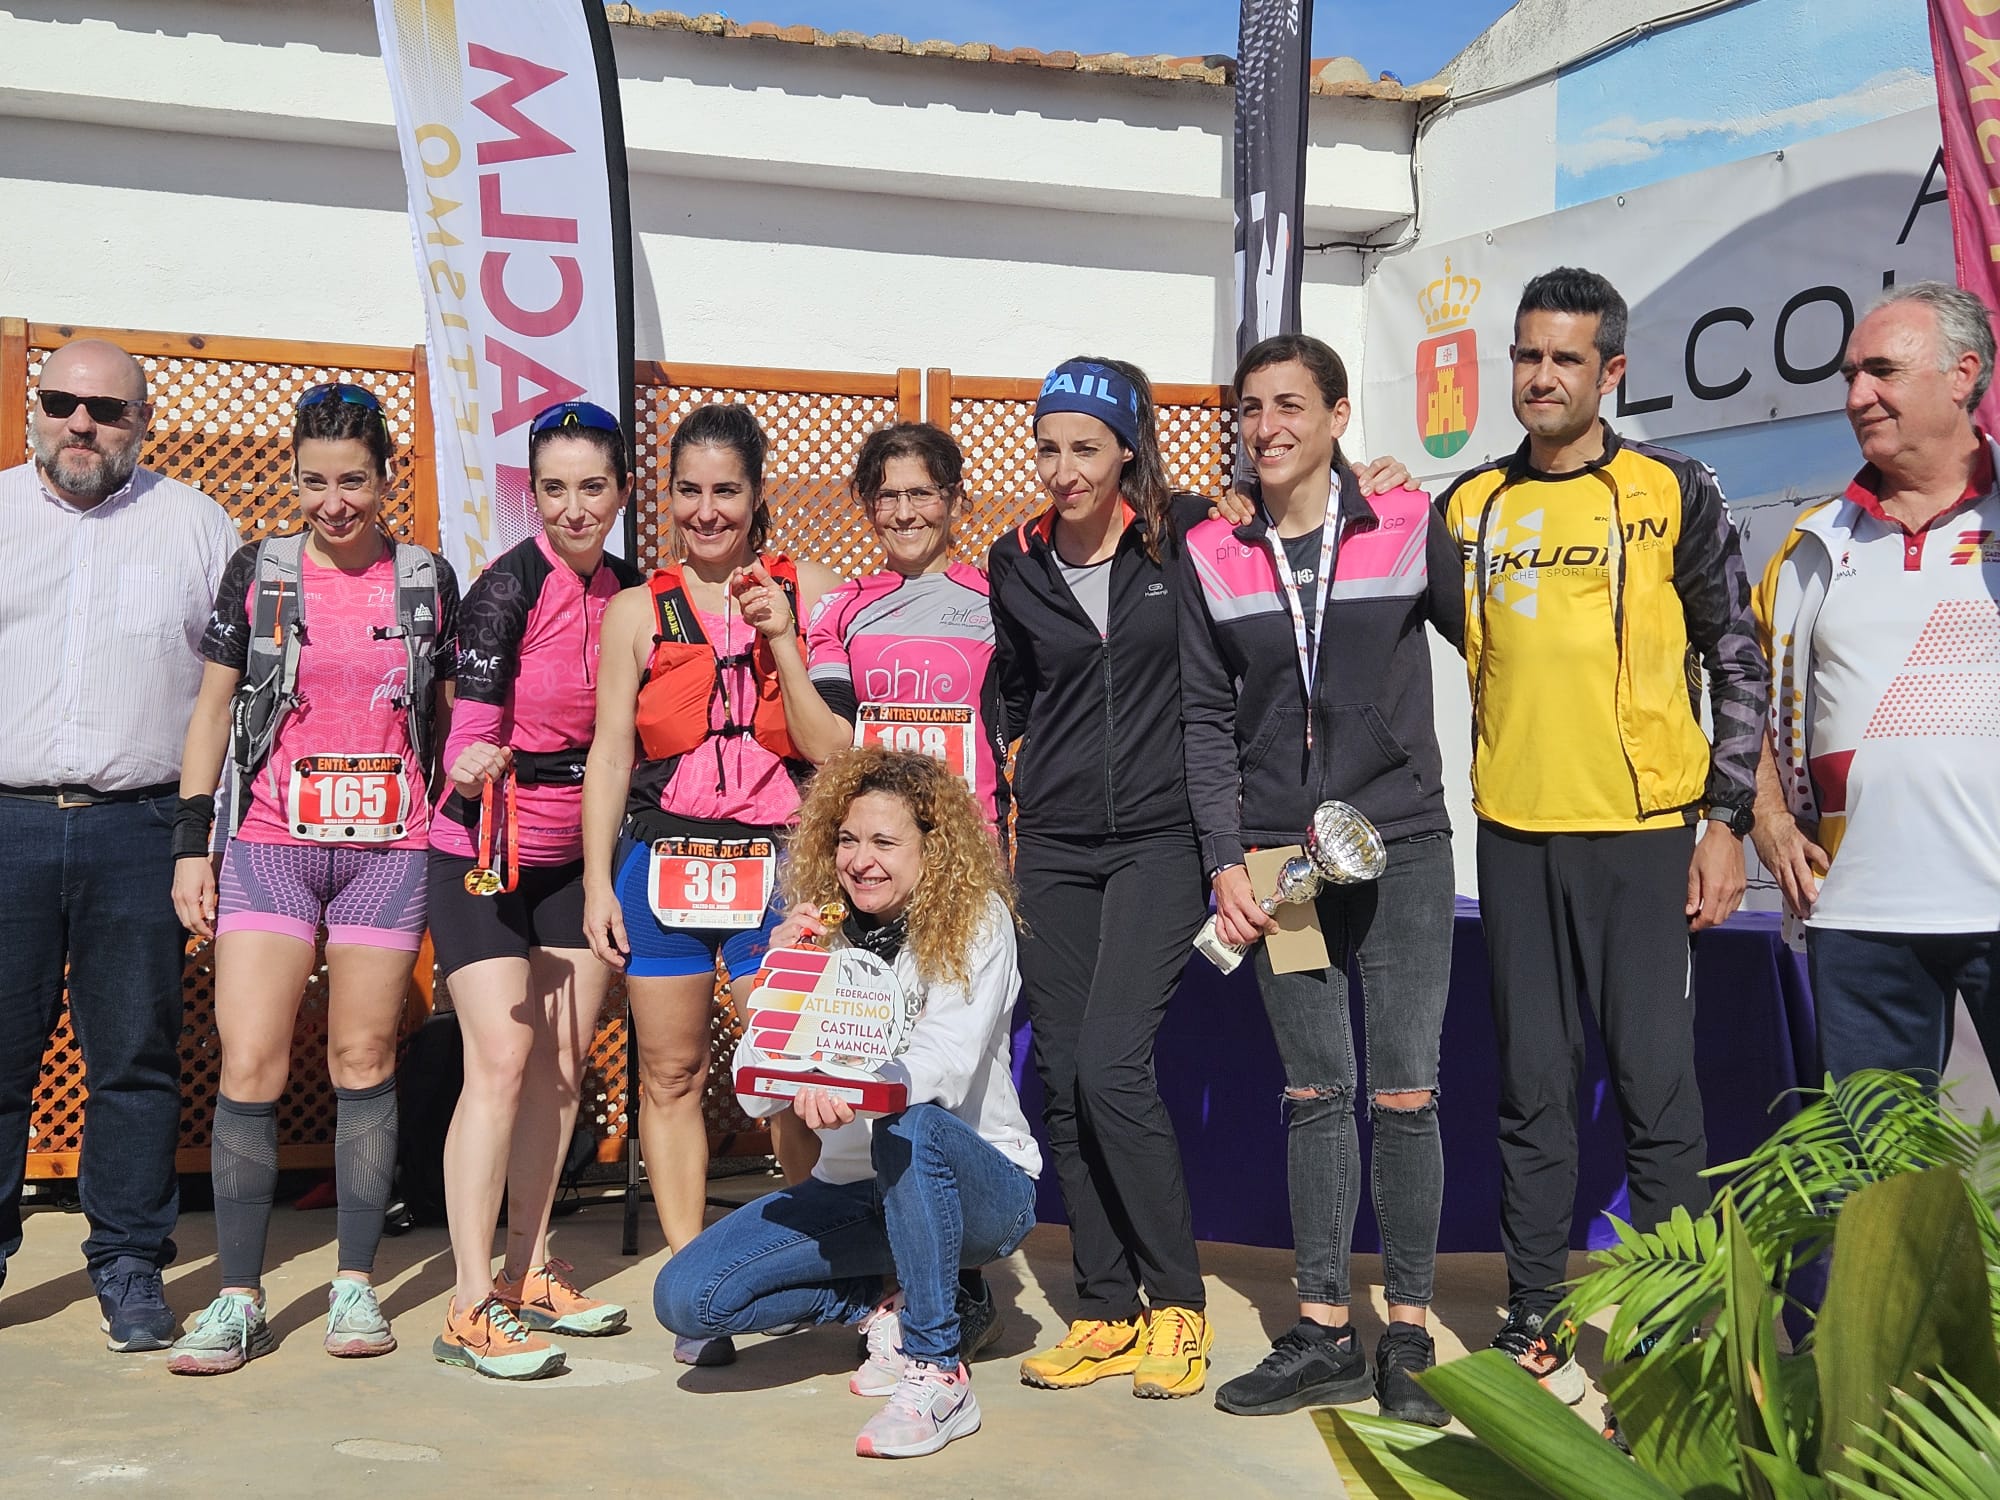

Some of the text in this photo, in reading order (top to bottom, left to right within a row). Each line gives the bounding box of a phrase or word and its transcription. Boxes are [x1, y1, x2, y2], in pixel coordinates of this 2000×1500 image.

[1491, 566, 1609, 585] CONCHEL SPORT TE
[879, 707, 969, 722] ENTREVOLCANES
[317, 758, 401, 771] ENTREOLCAE
[314, 776, 387, 818] 165
[684, 860, 737, 904] 36
[835, 987, 892, 1003] FEDERACIÓN
[805, 998, 891, 1021] ATLETISMO
[820, 1021, 883, 1040] CASTILLA
[816, 1037, 831, 1049] LA
[834, 1039, 888, 1056] MANCHA
